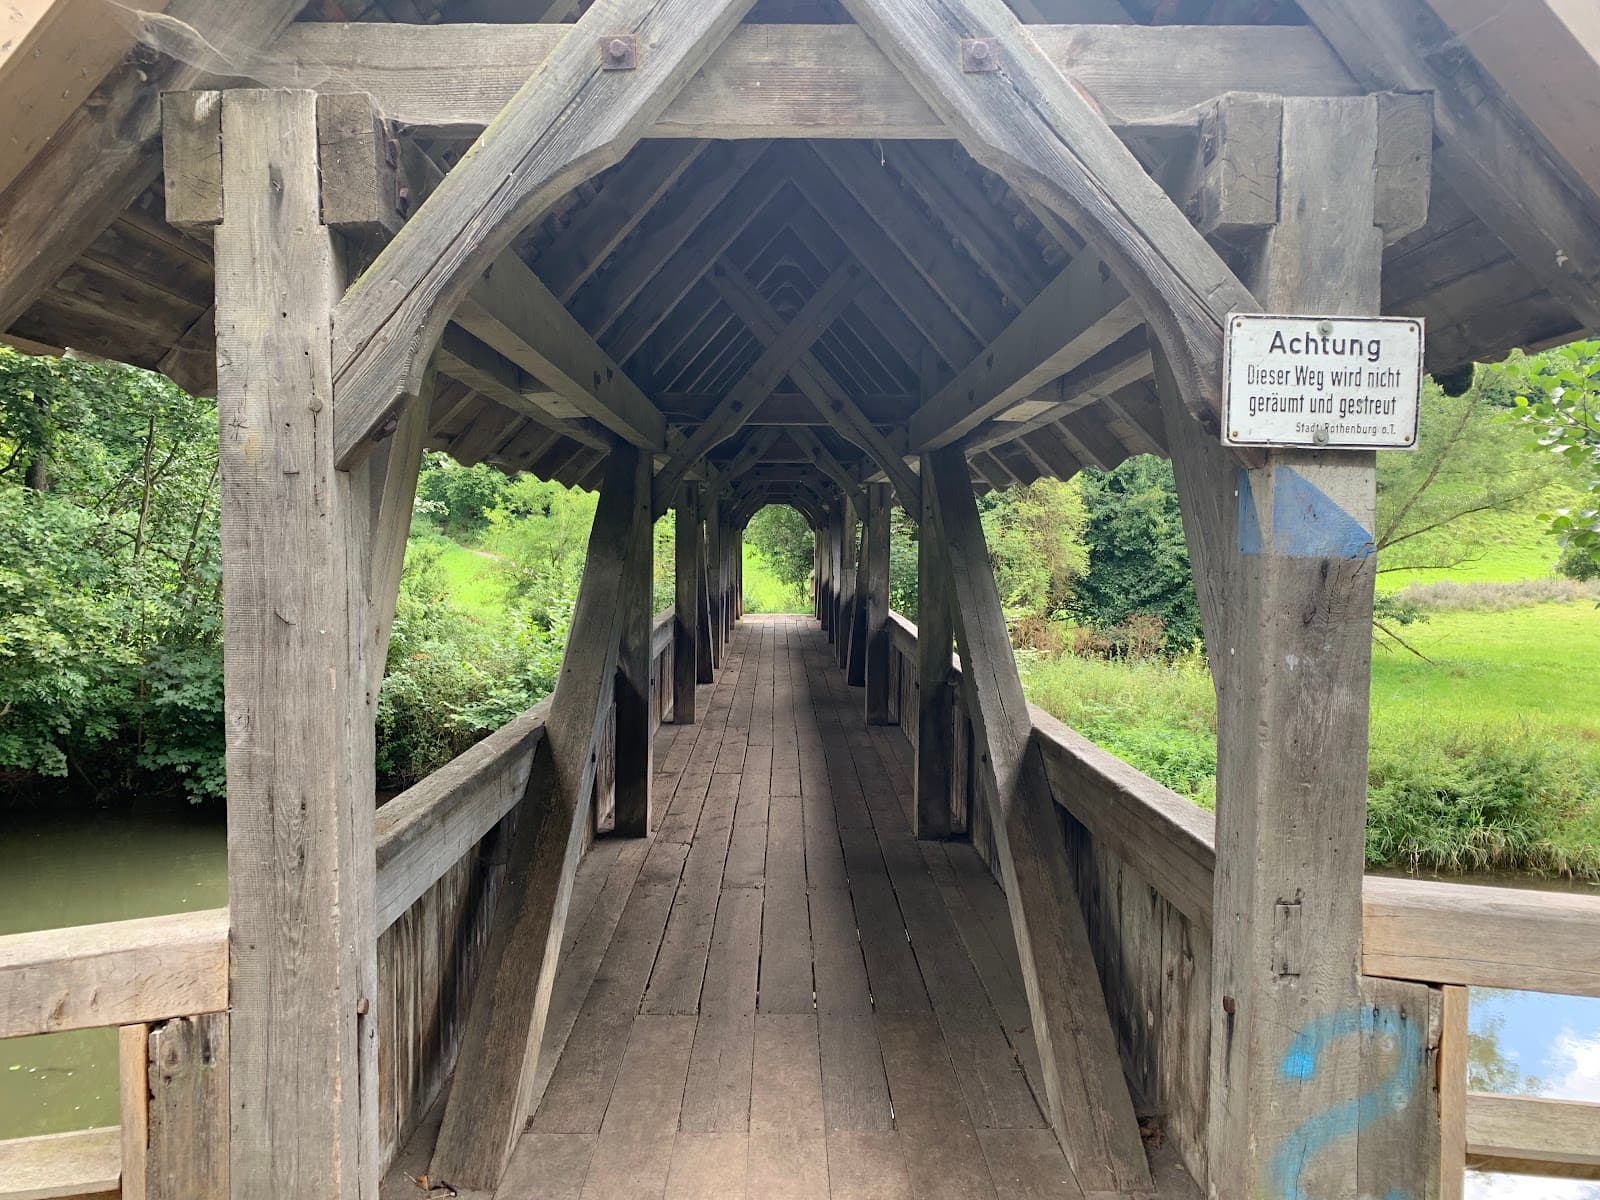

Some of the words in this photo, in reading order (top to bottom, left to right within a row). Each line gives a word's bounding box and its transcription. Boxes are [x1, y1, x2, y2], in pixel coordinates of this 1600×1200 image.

[1269, 330, 1381, 362] Achtung
[1247, 364, 1291, 385] Dieser
[1295, 365, 1324, 391] Weg
[1331, 366, 1361, 387] wird
[1367, 366, 1401, 388] nicht
[1249, 391, 1305, 416] geräumt
[1310, 393, 1333, 414] und
[1339, 395, 1397, 418] gestreut
[1296, 421, 1320, 433] Stadt
